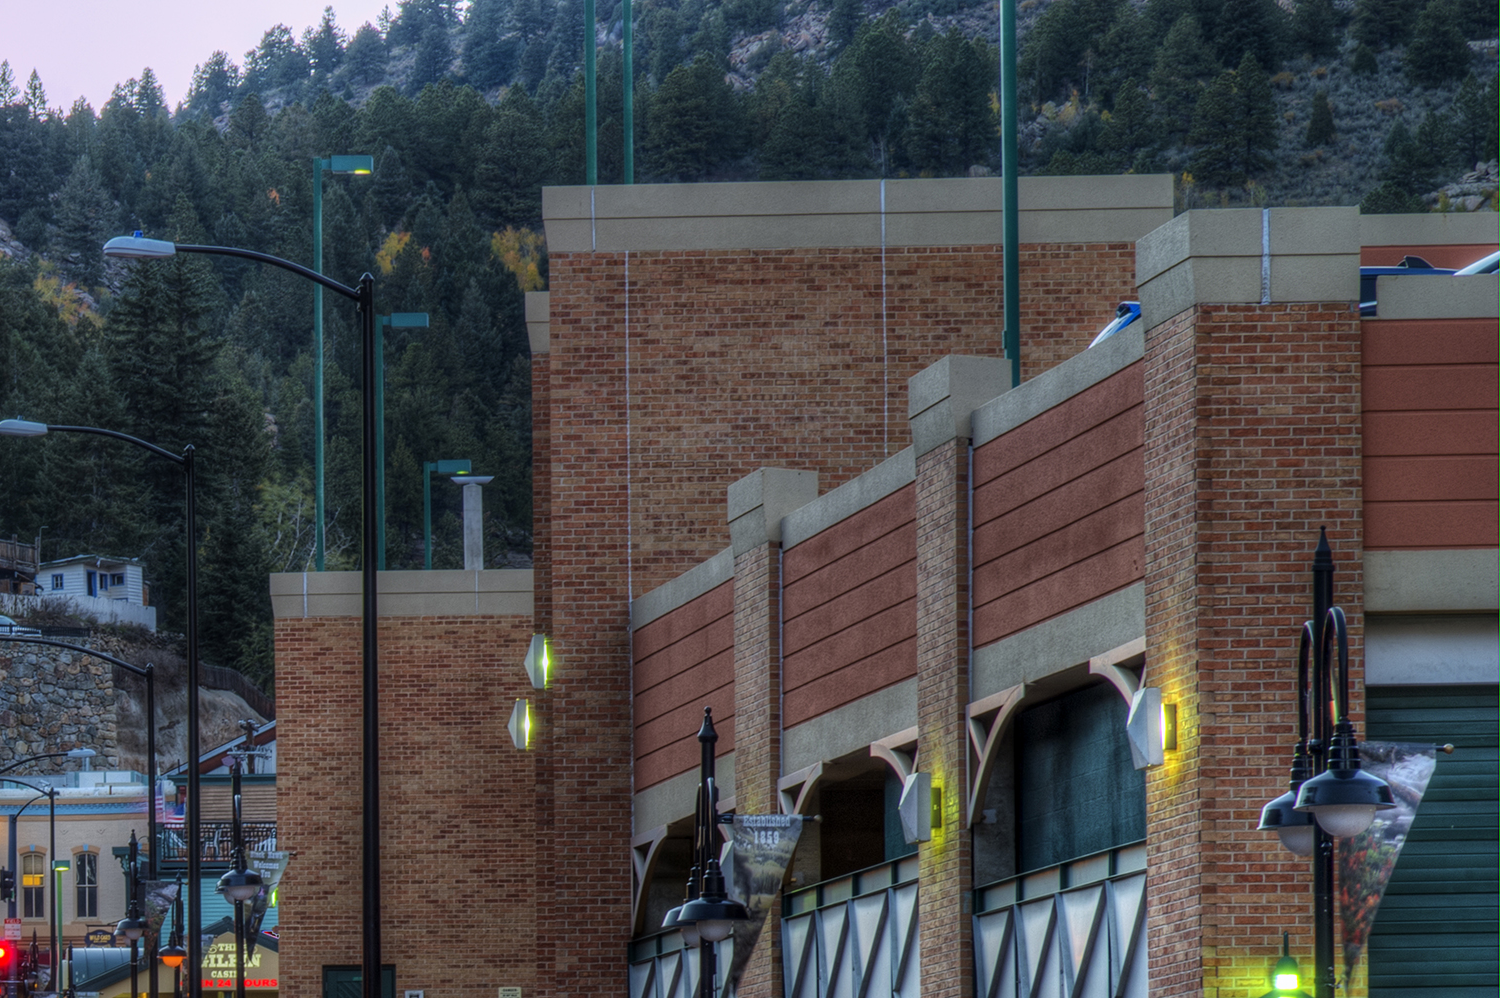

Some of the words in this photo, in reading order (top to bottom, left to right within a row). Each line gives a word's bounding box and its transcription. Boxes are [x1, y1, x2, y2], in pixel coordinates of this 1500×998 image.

[743, 815, 790, 827] Established
[211, 970, 247, 978] CASI
[217, 979, 231, 987] 24
[235, 979, 277, 987] OURS
